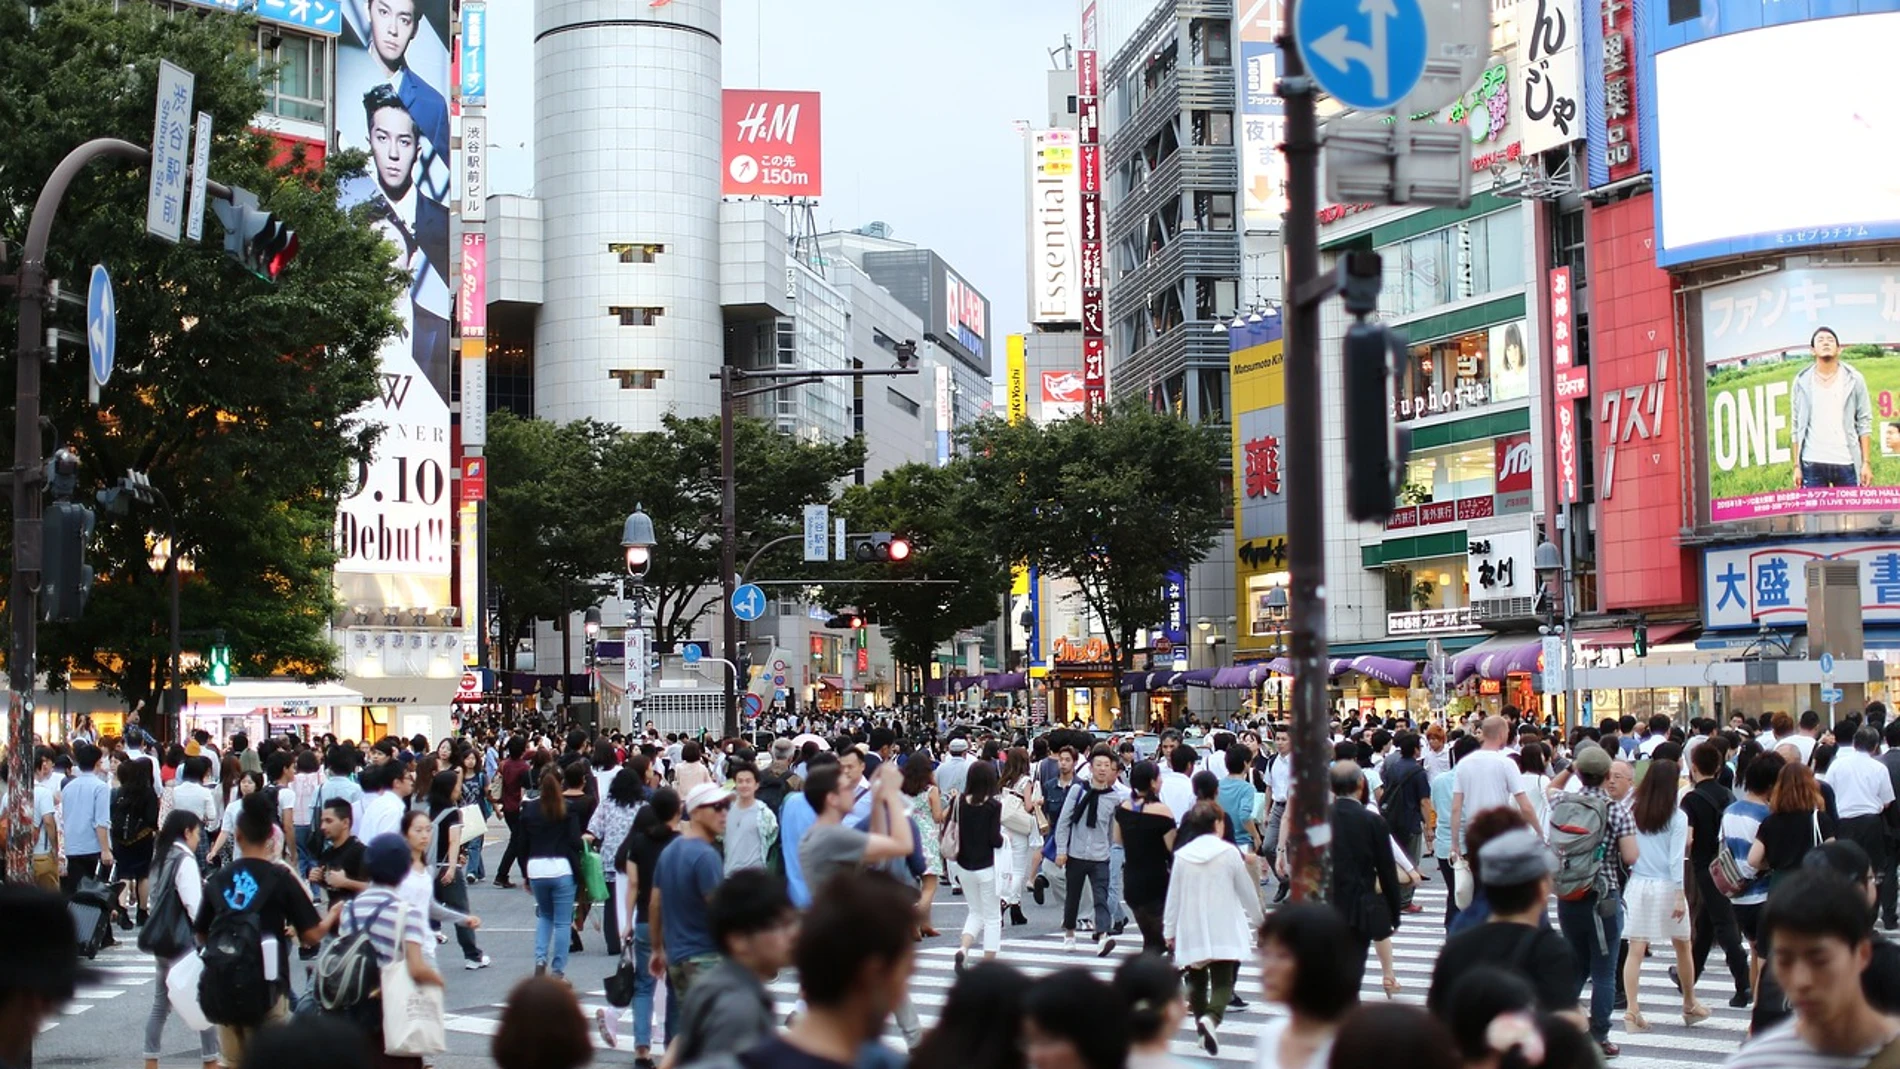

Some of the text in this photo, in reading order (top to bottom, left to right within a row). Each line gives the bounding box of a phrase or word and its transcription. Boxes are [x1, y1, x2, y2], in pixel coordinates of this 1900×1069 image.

[157, 99, 170, 163] Shibuya
[736, 102, 800, 145] H&M
[467, 126, 481, 212] 渋谷駅前ビル
[761, 155, 797, 167] この先
[761, 168, 809, 185] 150m
[463, 234, 484, 246] 5F
[1037, 179, 1067, 316] Essential
[1775, 225, 1869, 244] ミュゼプラチナム
[1601, 349, 1669, 500] クスリ
[1713, 381, 1791, 472] ONE
[1245, 436, 1281, 498] 薬
[1499, 441, 1532, 482] JTB
[341, 511, 444, 563] Debut!!
[1716, 552, 1900, 612] 大盛書
